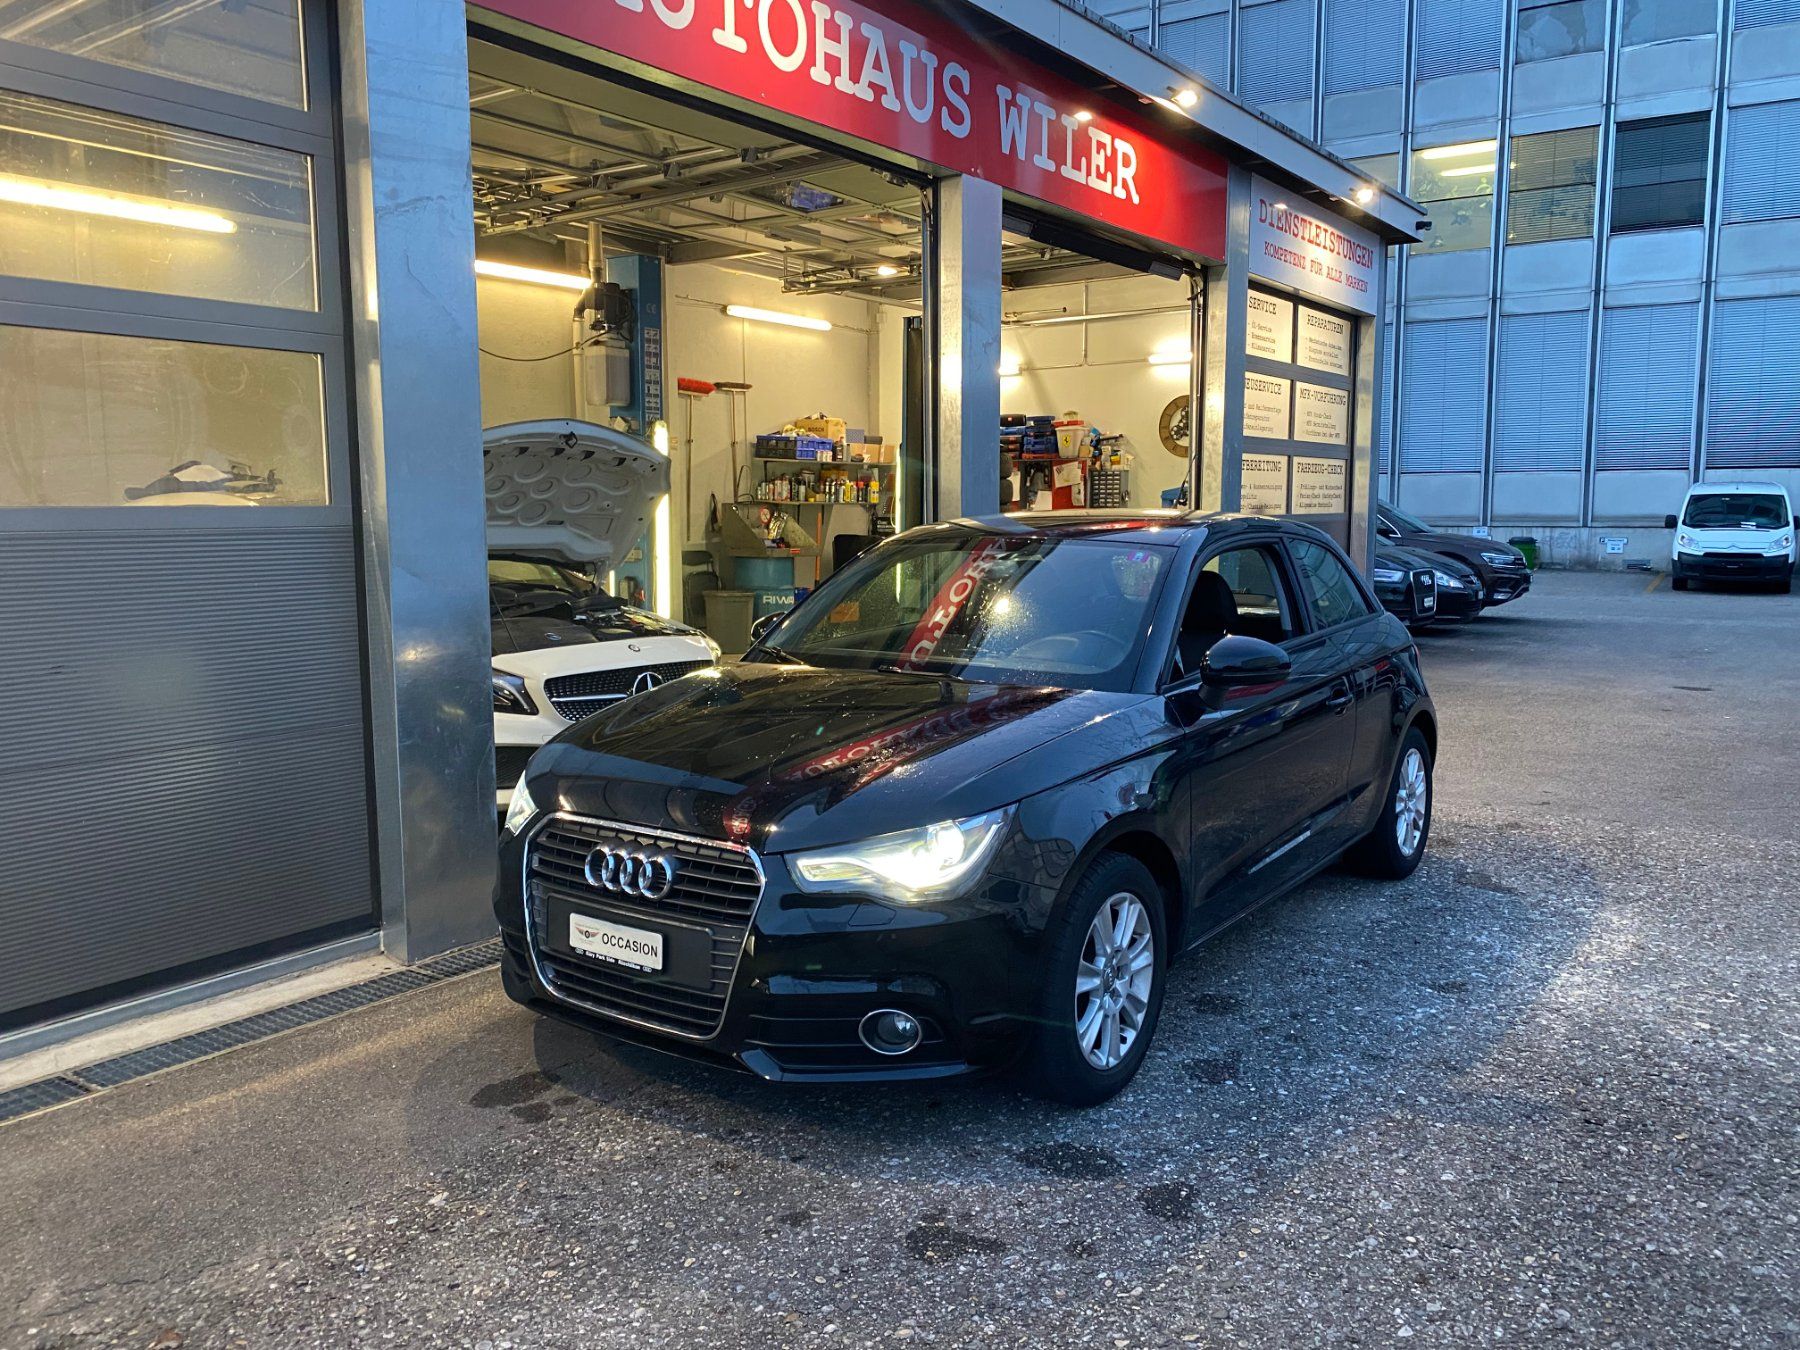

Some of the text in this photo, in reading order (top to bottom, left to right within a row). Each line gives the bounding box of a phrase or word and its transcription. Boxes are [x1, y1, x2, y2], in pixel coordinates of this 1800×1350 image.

[615, 0, 1140, 205] TOHAUS WILER
[1259, 198, 1374, 270] DIENSTLEISTUNGEN
[1264, 241, 1368, 293] KOMPETENZ FÜR ALLE MARKEN
[1248, 296, 1277, 315] SERVICE
[1245, 378, 1282, 395] EUSERVICE
[602, 933, 658, 957] OCCASION
